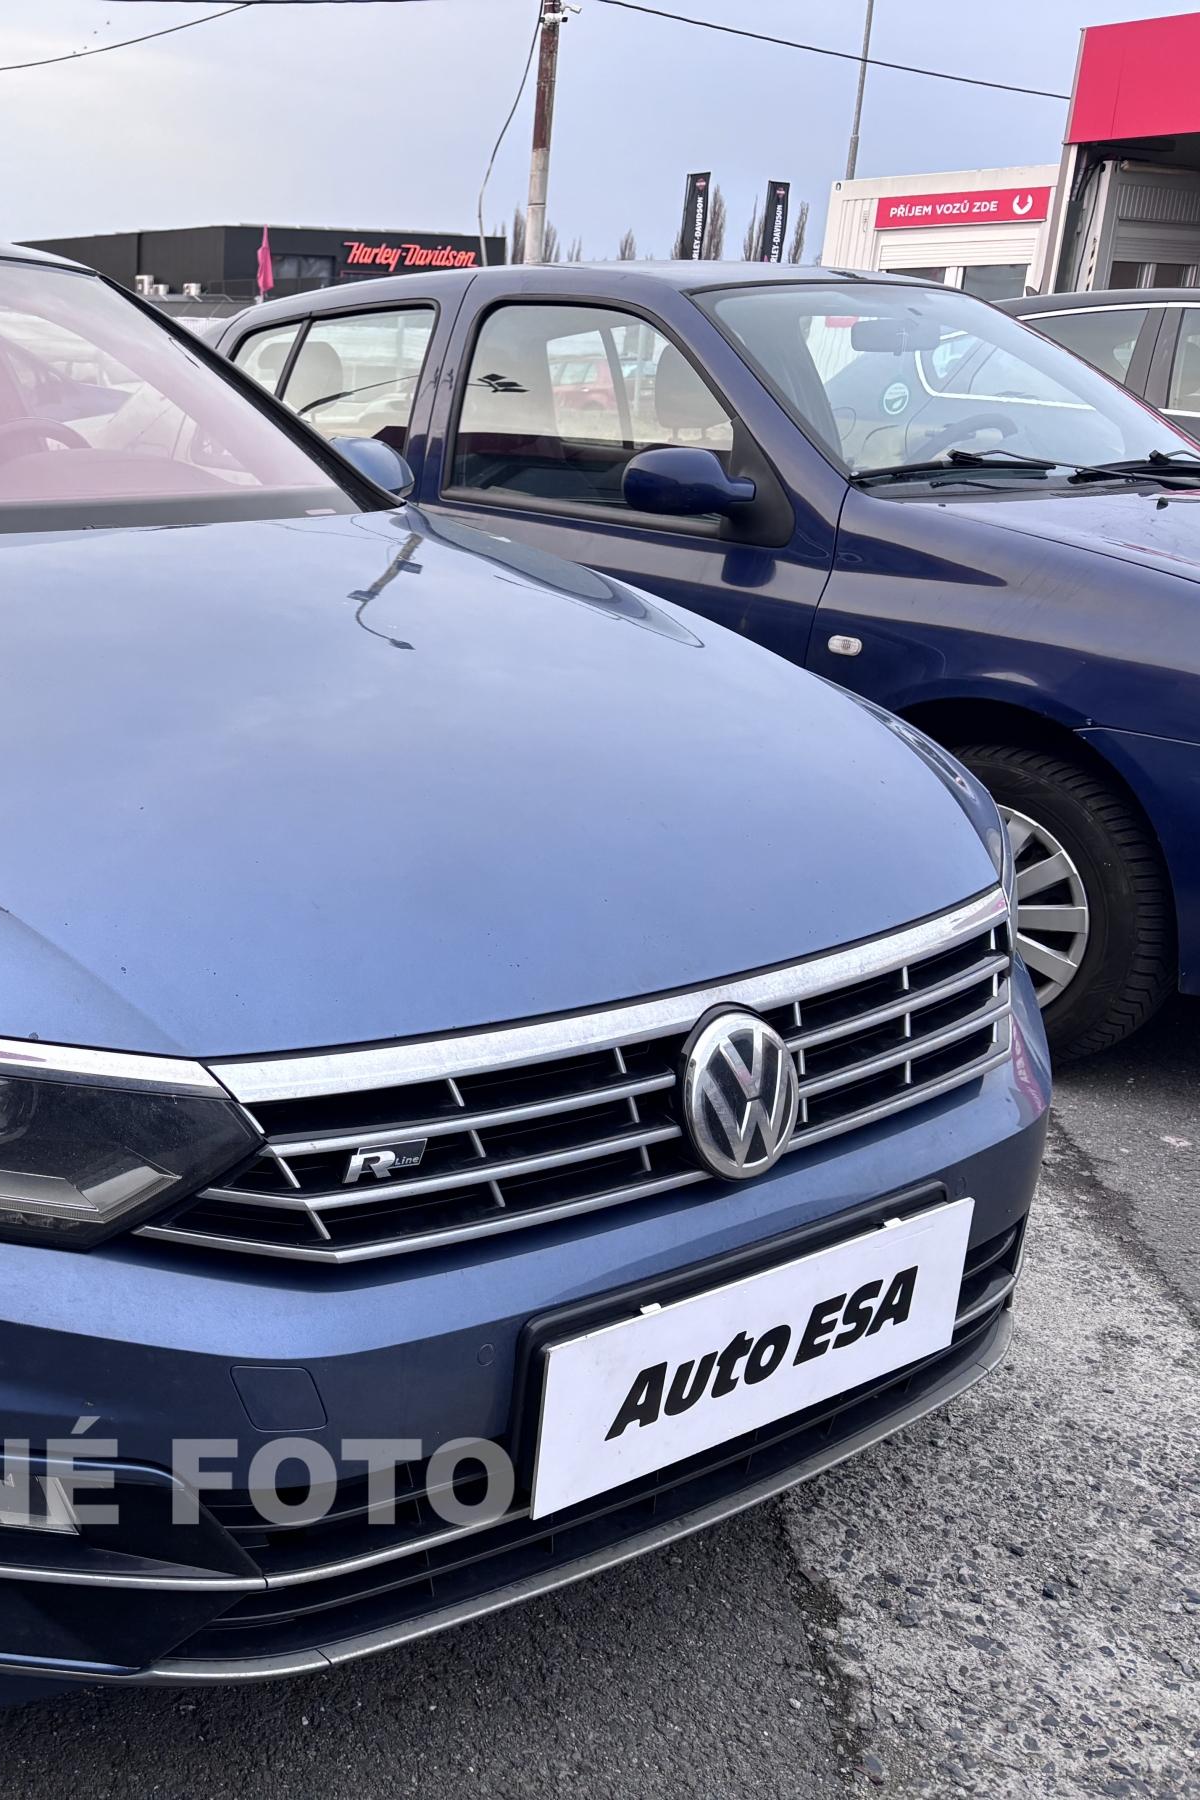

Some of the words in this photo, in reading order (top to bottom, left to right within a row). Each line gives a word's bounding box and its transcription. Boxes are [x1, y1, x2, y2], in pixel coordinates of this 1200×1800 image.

[691, 196, 704, 260] RLEY-DAVIDSON
[770, 204, 783, 263] RLEY-DAVIDSON
[889, 204, 932, 217] PŘÍJEM
[936, 200, 970, 215] VOZŮ
[972, 200, 999, 213] ZDE
[344, 241, 479, 272] Harley-Davidson
[604, 1324, 791, 1442] Auto
[793, 1265, 919, 1367] ESA
